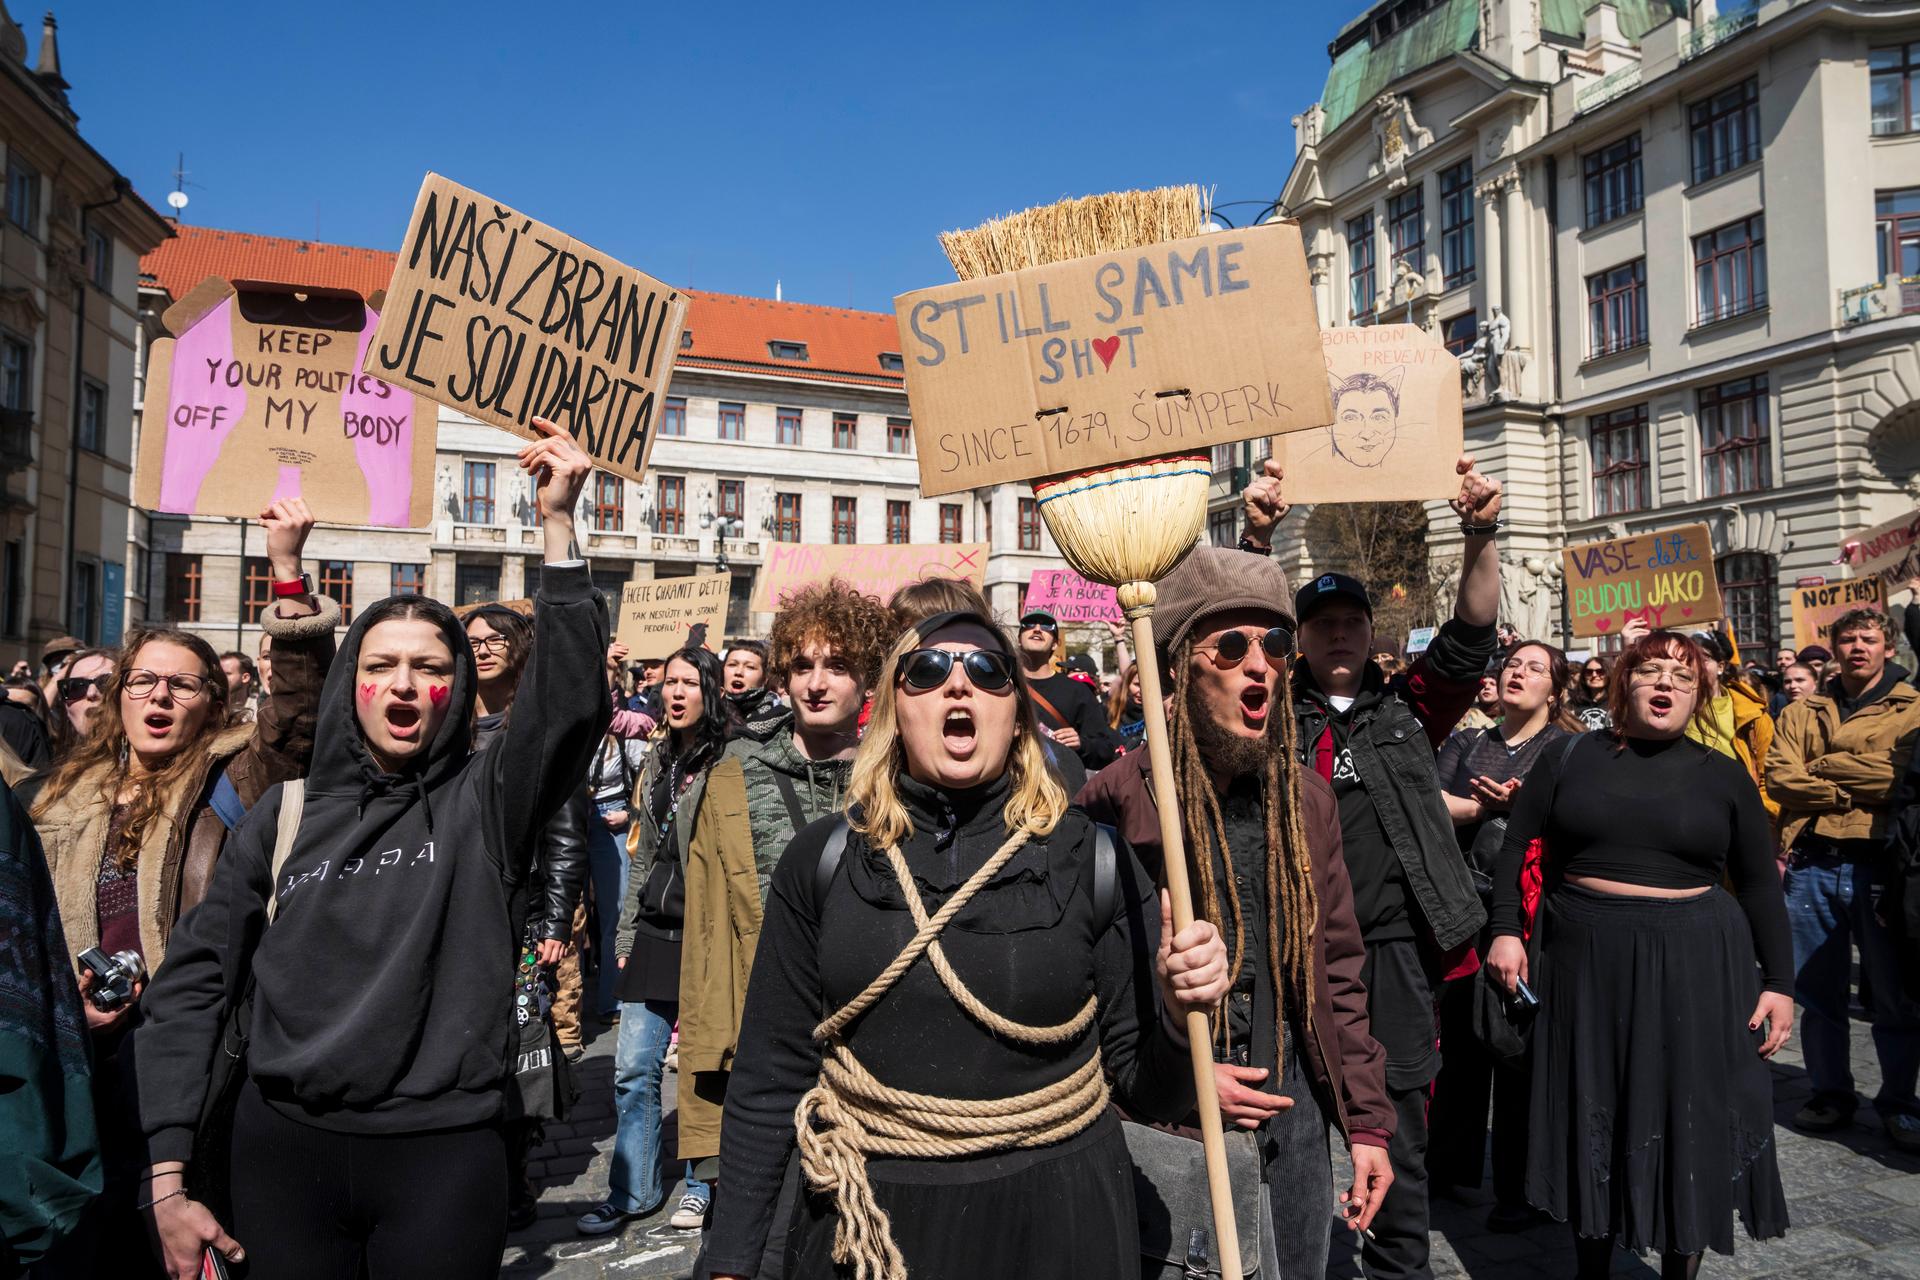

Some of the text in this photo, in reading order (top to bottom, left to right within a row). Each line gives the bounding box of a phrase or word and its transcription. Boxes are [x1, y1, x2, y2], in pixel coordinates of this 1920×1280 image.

[409, 191, 678, 378] NAŠÍ ZBRANÍ
[910, 241, 1251, 366] STILL SAME
[258, 328, 332, 355] KEEP
[1320, 327, 1405, 346] BORTION
[1363, 348, 1443, 368] PREVENT
[206, 358, 282, 390] YOUR
[382, 289, 656, 472] JE SOLIDARITA
[173, 396, 408, 448] OFF MY BODY
[939, 382, 1293, 473] SINCE 1679, ŠUMPERK
[1571, 540, 1641, 579] VAŠE
[622, 585, 653, 604] CHCETE
[1046, 587, 1109, 600] JE A BUDE
[1575, 570, 1704, 617] BUDOU JAKO
[1802, 586, 1841, 608] NOT
[1844, 578, 1880, 604] EVERY
[632, 611, 647, 621] TAK
[684, 609, 692, 617] NA
[1623, 604, 1669, 628] MY
